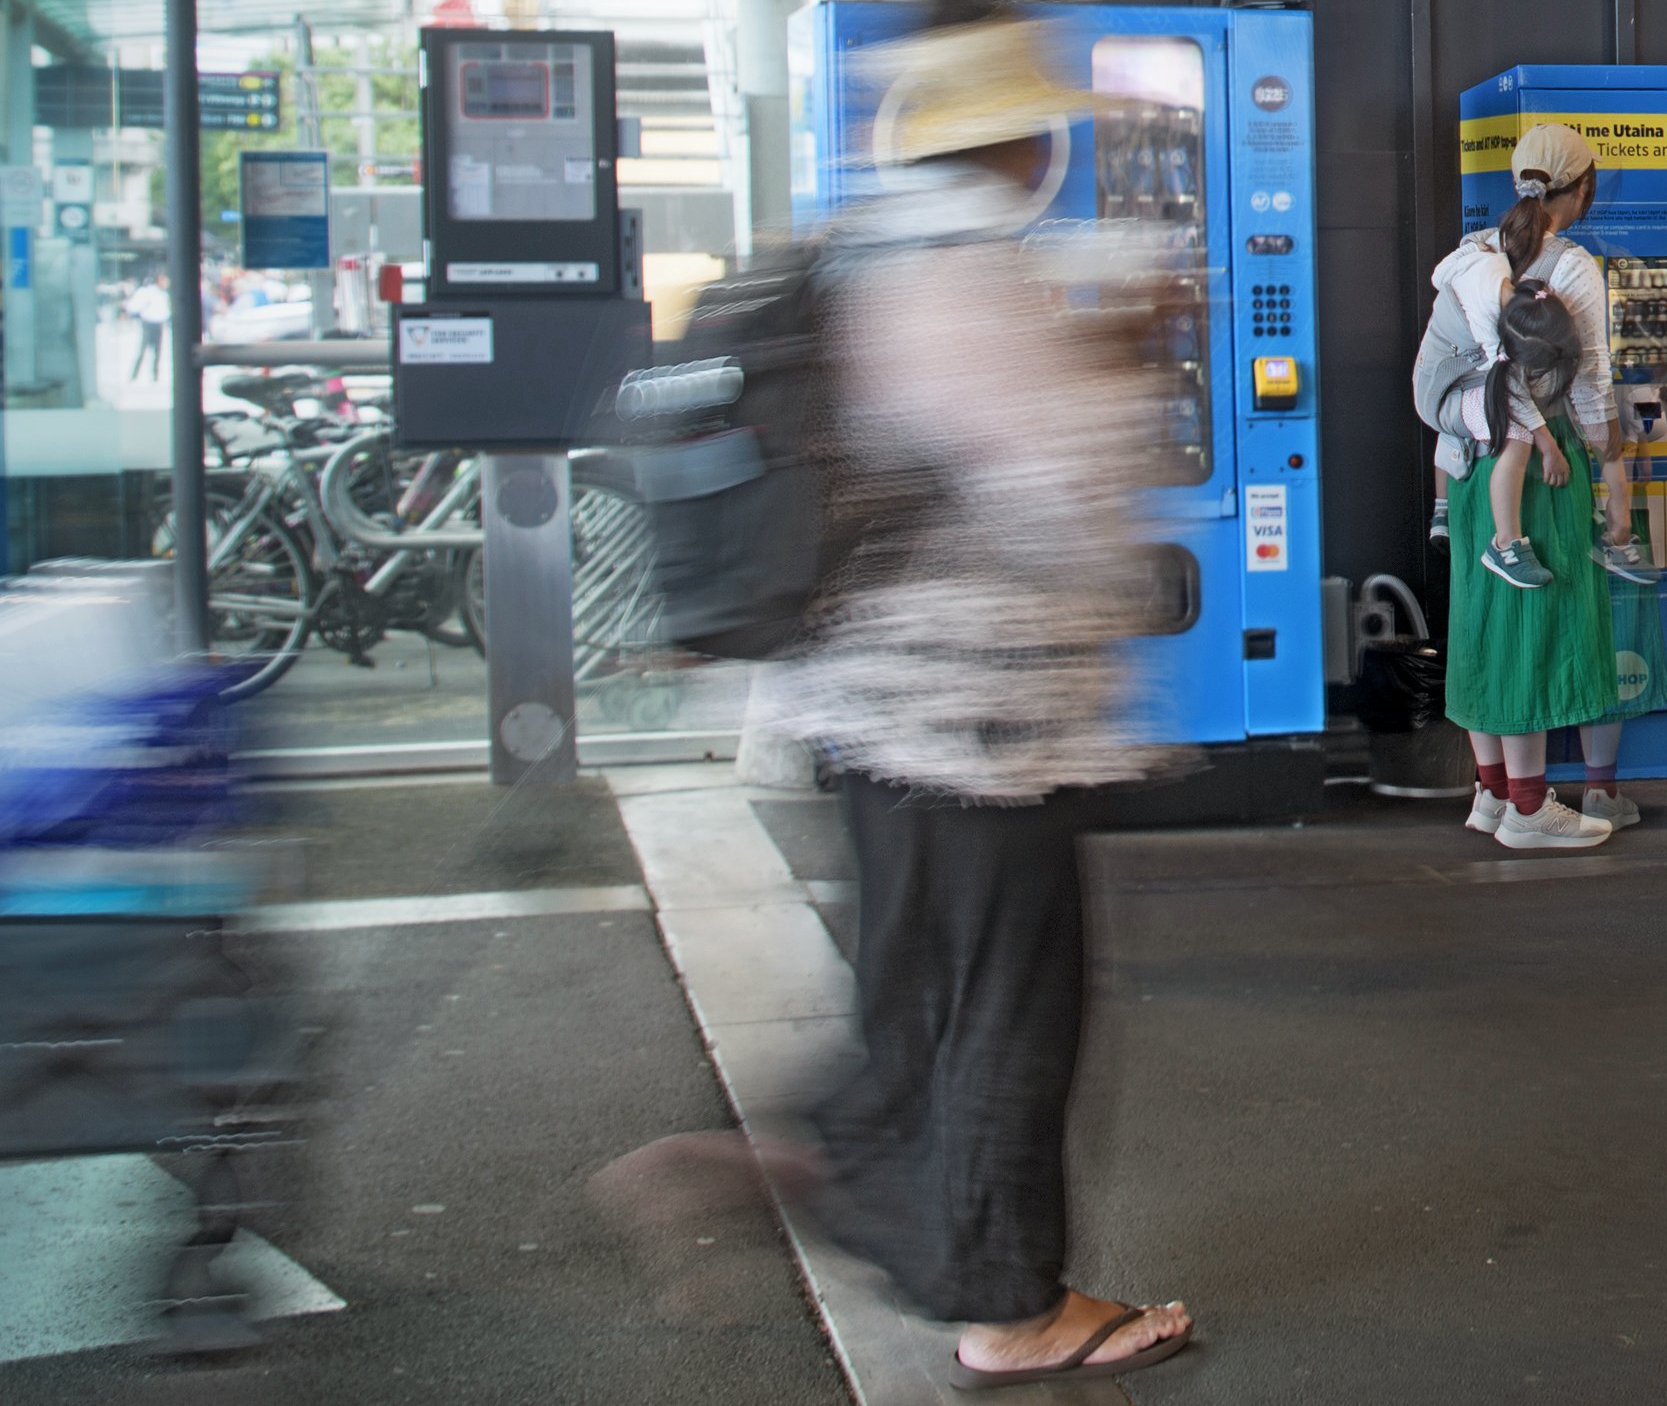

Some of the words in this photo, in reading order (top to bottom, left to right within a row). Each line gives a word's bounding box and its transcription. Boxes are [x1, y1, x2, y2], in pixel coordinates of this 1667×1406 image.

[1586, 126, 1610, 138] me
[1613, 124, 1664, 138] Utaina
[1461, 140, 1476, 152] Tickets
[1475, 138, 1484, 151] and
[1484, 137, 1491, 150] AT
[1490, 136, 1501, 150] HOP
[1597, 143, 1649, 157] Tickets
[1253, 525, 1283, 536] VISA
[1617, 673, 1648, 686] HOP
